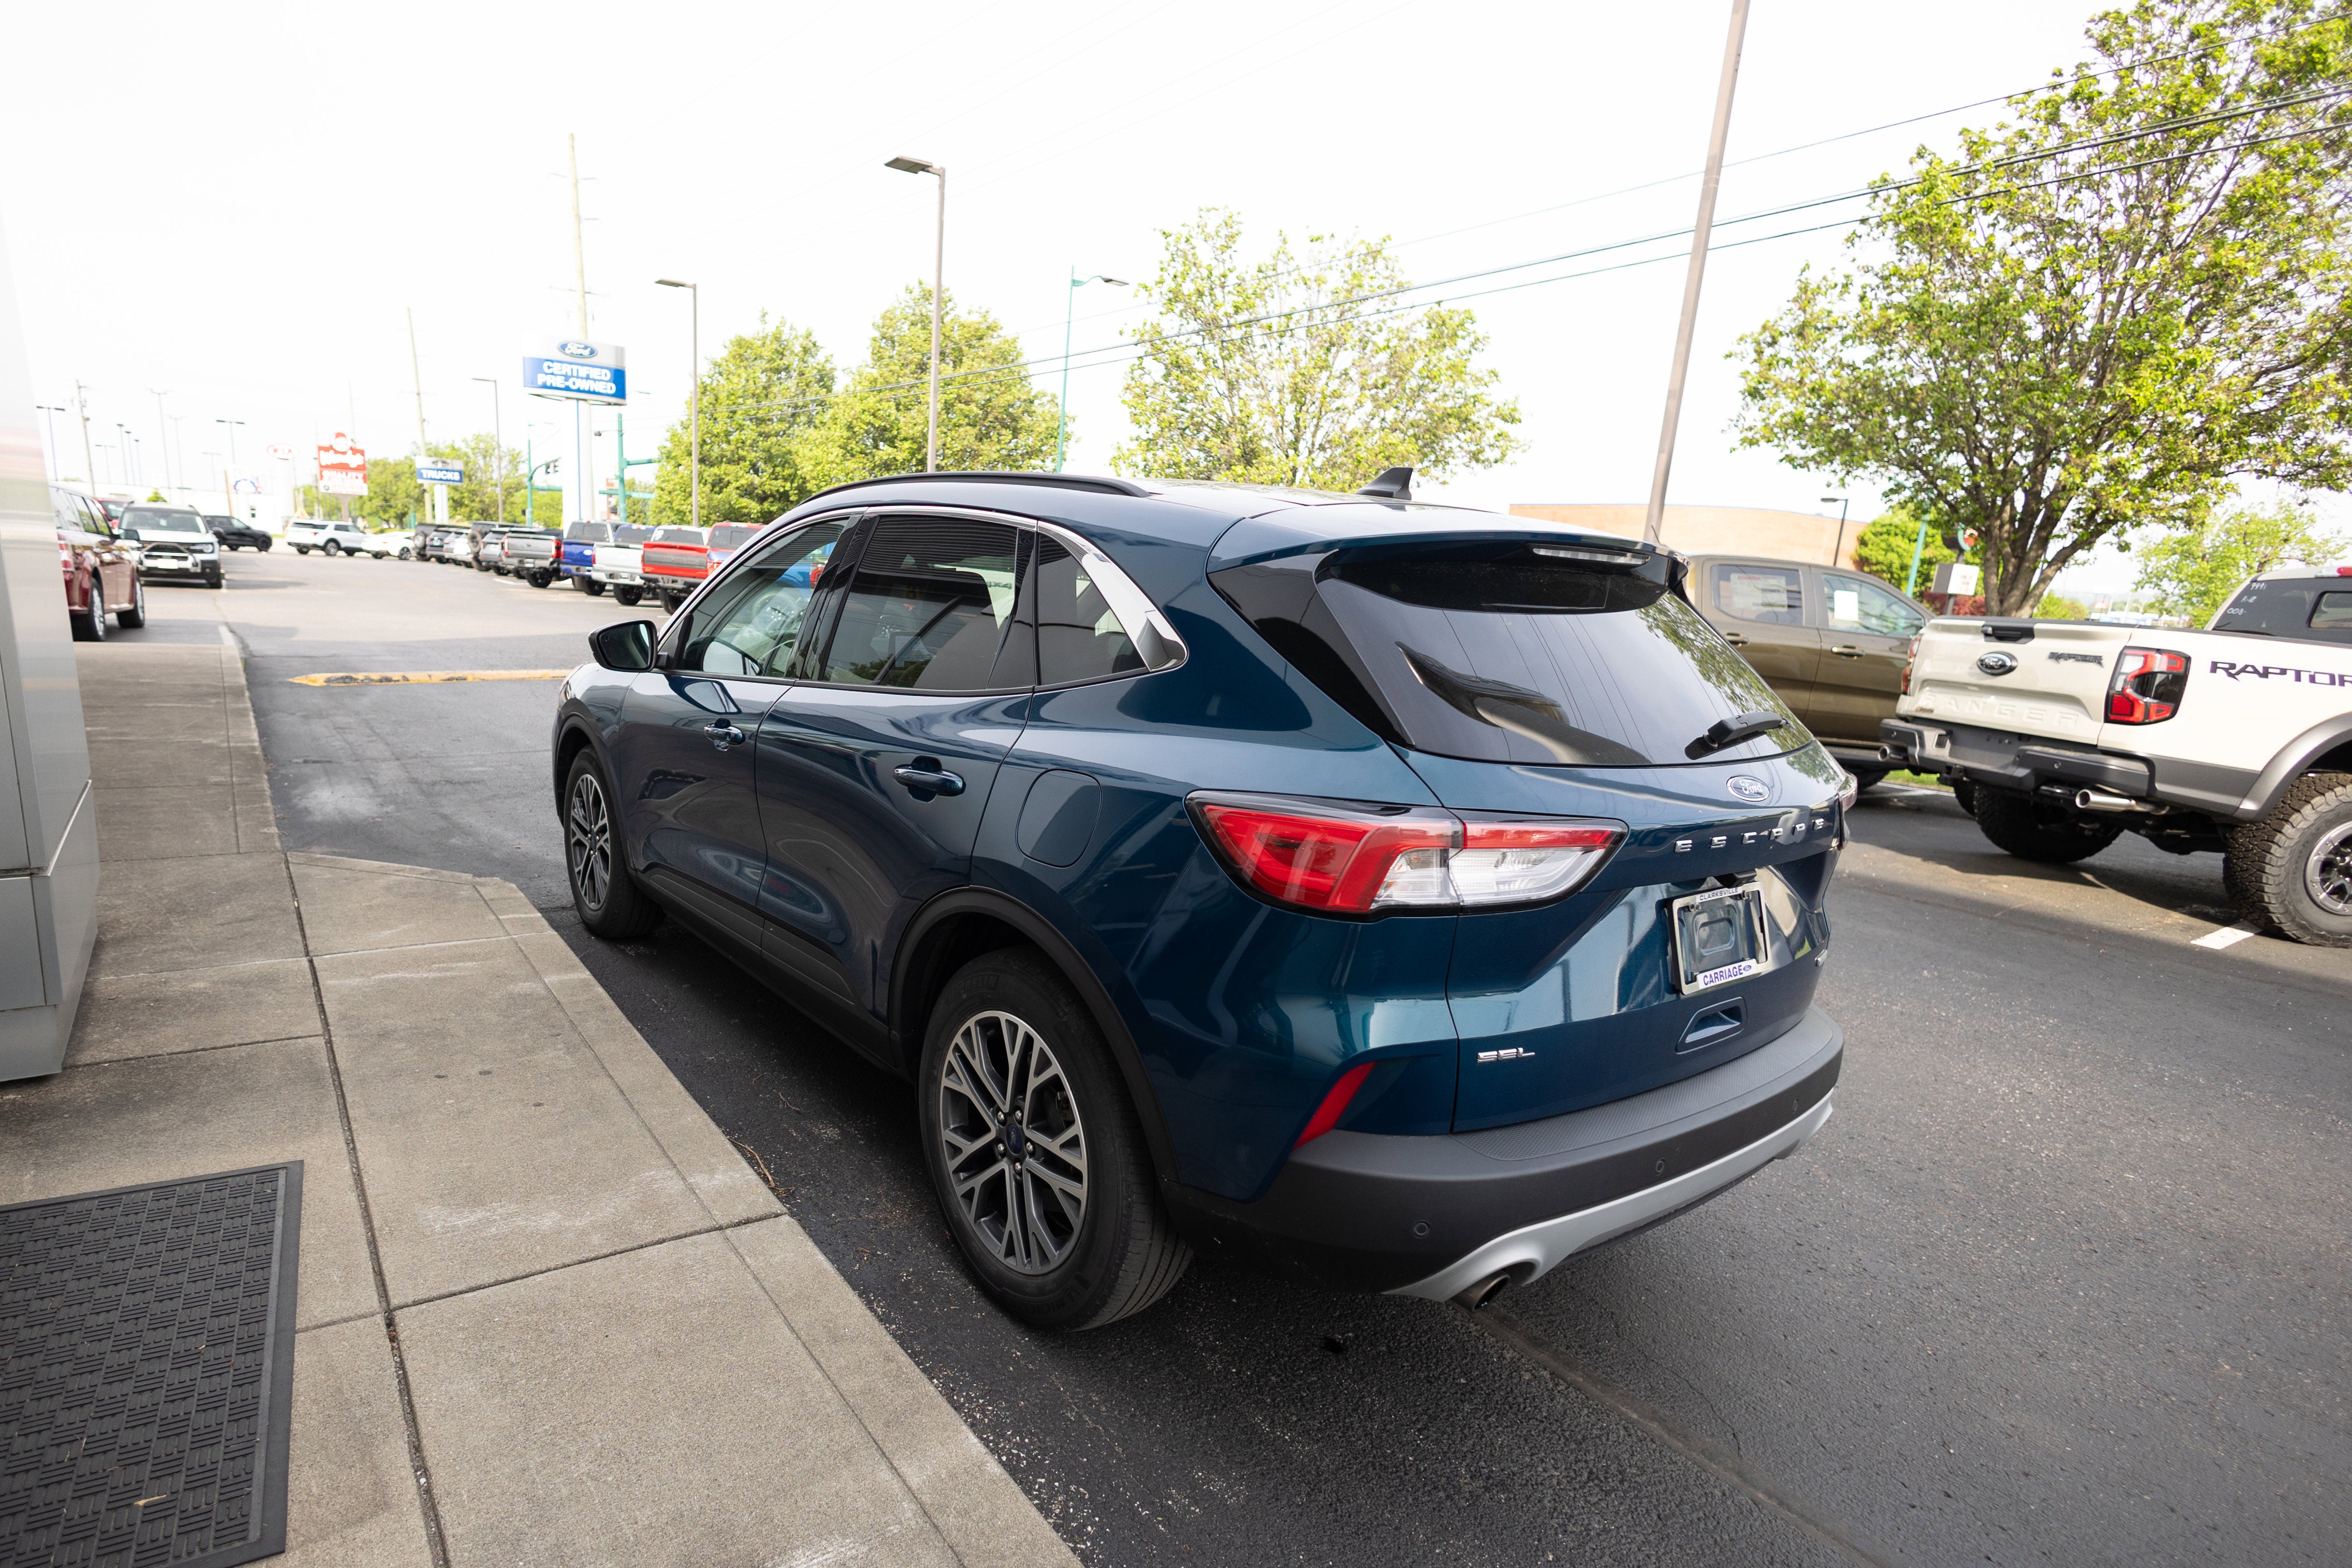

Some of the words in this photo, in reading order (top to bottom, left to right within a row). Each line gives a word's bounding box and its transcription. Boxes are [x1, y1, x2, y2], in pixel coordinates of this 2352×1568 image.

[564, 342, 591, 356] Ford
[543, 361, 611, 381] CERTIFIED
[537, 374, 617, 394] PRE-OWNED
[272, 447, 294, 456] KIA
[421, 469, 460, 481] TRUCKS
[1919, 694, 2080, 728] RANGER
[1739, 780, 1764, 794] Ford
[1675, 818, 1824, 853] ESCAPE
[1700, 887, 1738, 901] CLARKSVILLE
[1703, 965, 1743, 986] CARRIAGE
[1477, 1047, 1536, 1063] SEL
